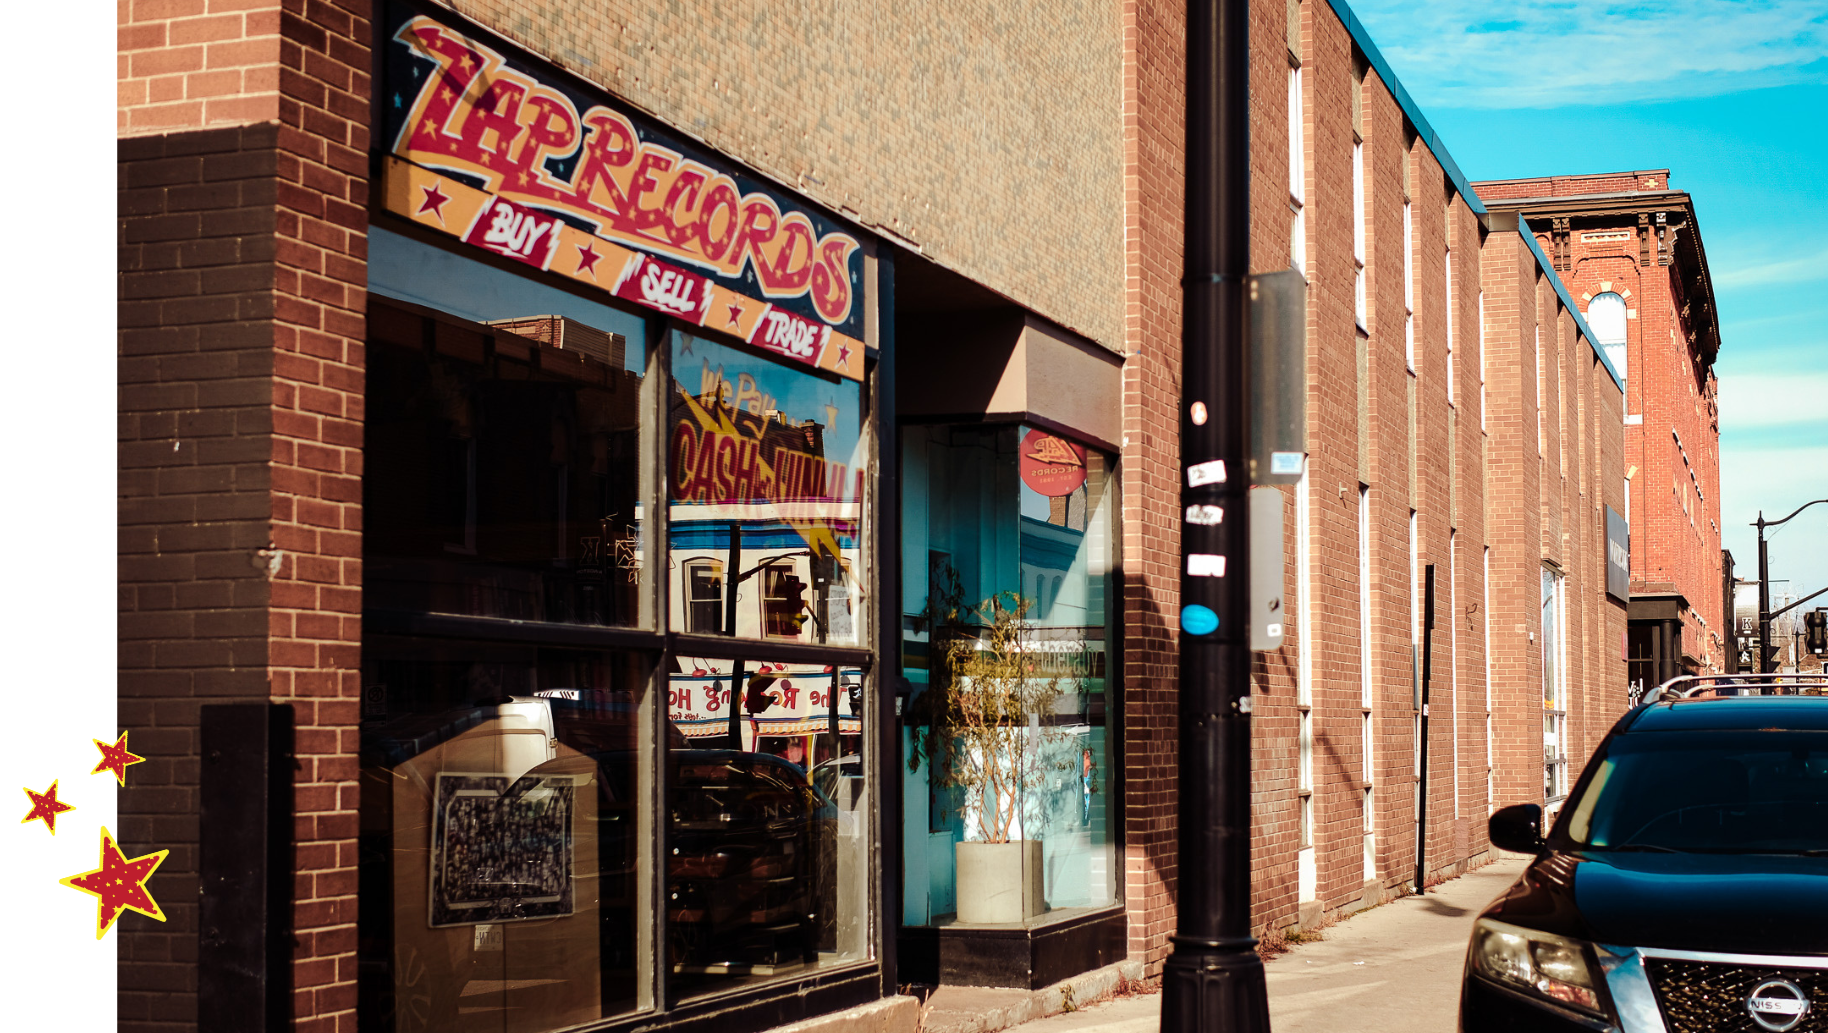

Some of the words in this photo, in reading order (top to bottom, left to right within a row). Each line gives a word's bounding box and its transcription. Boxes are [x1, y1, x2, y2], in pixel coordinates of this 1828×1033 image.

[394, 16, 583, 200] ZAP
[582, 106, 860, 324] RECORDS
[486, 202, 552, 256] BUY
[640, 260, 698, 313] SELL
[765, 311, 820, 357] TRADE
[701, 356, 733, 408] We
[732, 371, 776, 440] Pay
[672, 418, 760, 514] CASH
[1742, 617, 1753, 630] K
